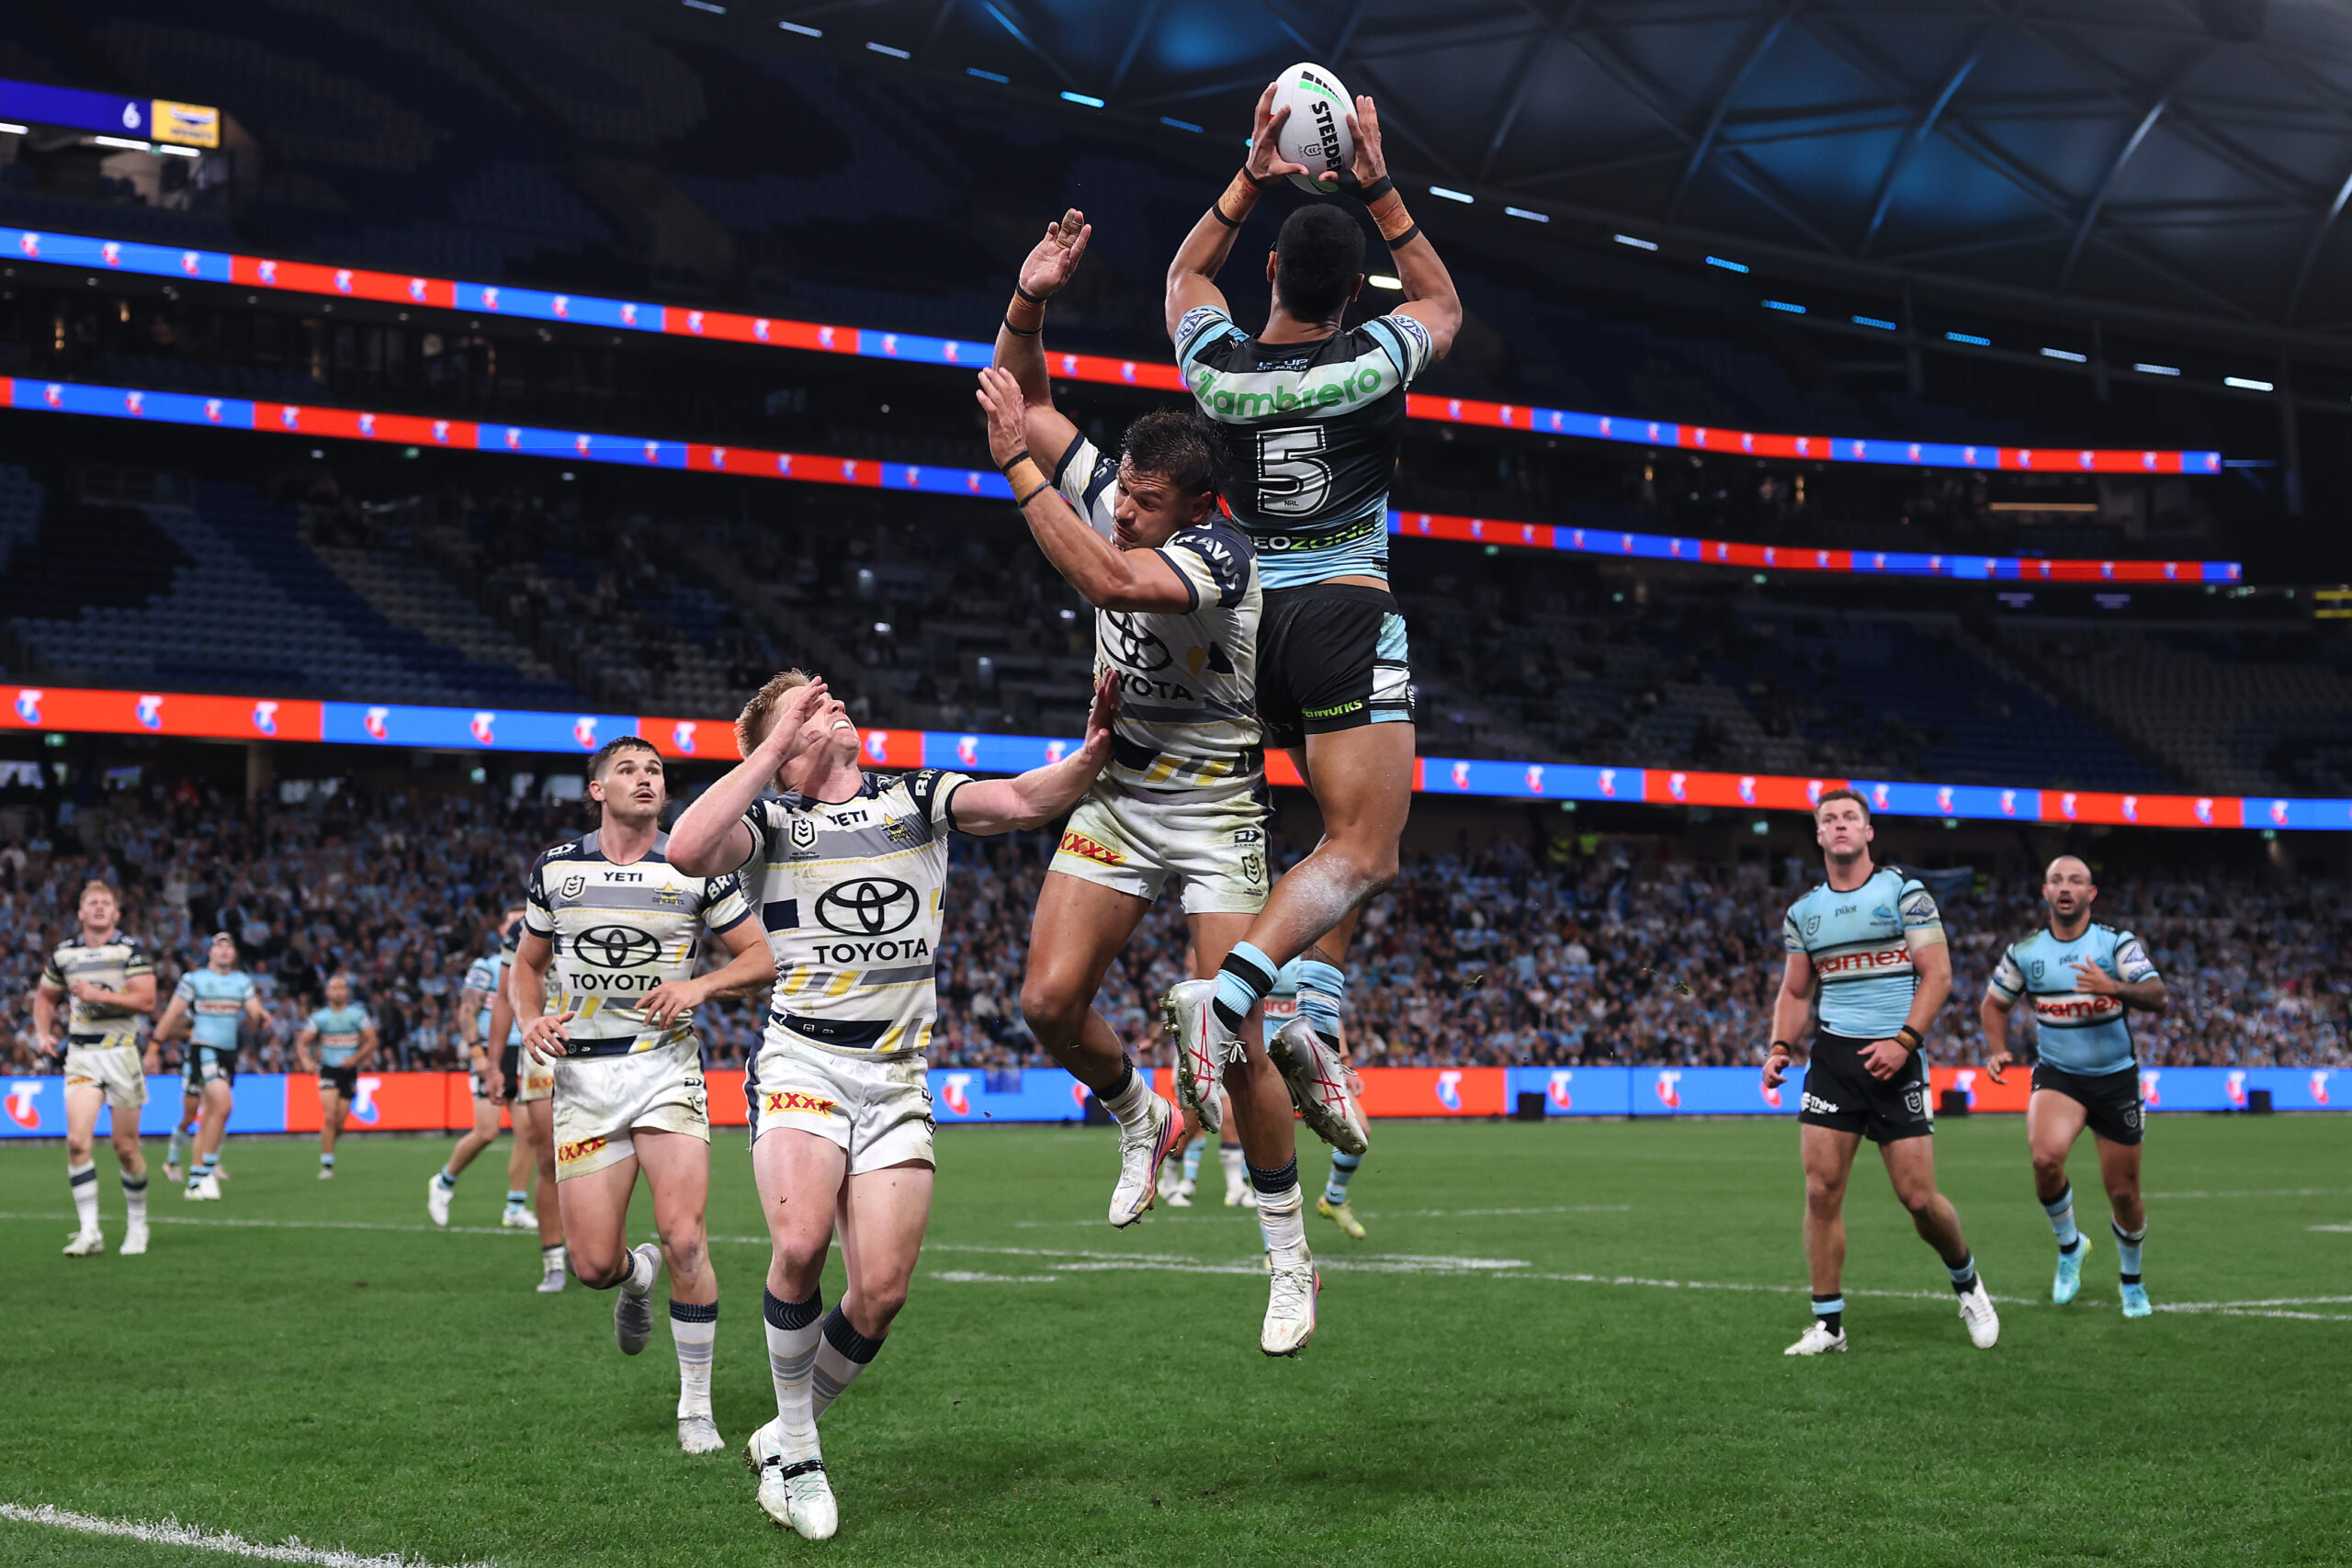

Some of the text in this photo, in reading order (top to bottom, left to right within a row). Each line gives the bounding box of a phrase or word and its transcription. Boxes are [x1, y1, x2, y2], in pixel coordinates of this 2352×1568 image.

[122, 102, 141, 129] 6
[1312, 101, 1342, 172] STEEDE
[1196, 368, 1382, 416] Zambrero
[1257, 425, 1332, 517] 5
[1246, 522, 1374, 550] EOZONE
[1098, 660, 1193, 701] YOTA
[827, 809, 869, 826] YETI
[1061, 832, 1121, 864] XXXX
[604, 872, 642, 882] YETI
[1835, 904, 1857, 918] pilot
[812, 937, 928, 964] TOYOTA
[570, 974, 662, 991] TOYOTA
[770, 1092, 834, 1115] XXXX
[1811, 1096, 1838, 1113] Think
[559, 1139, 603, 1162] XXXX
